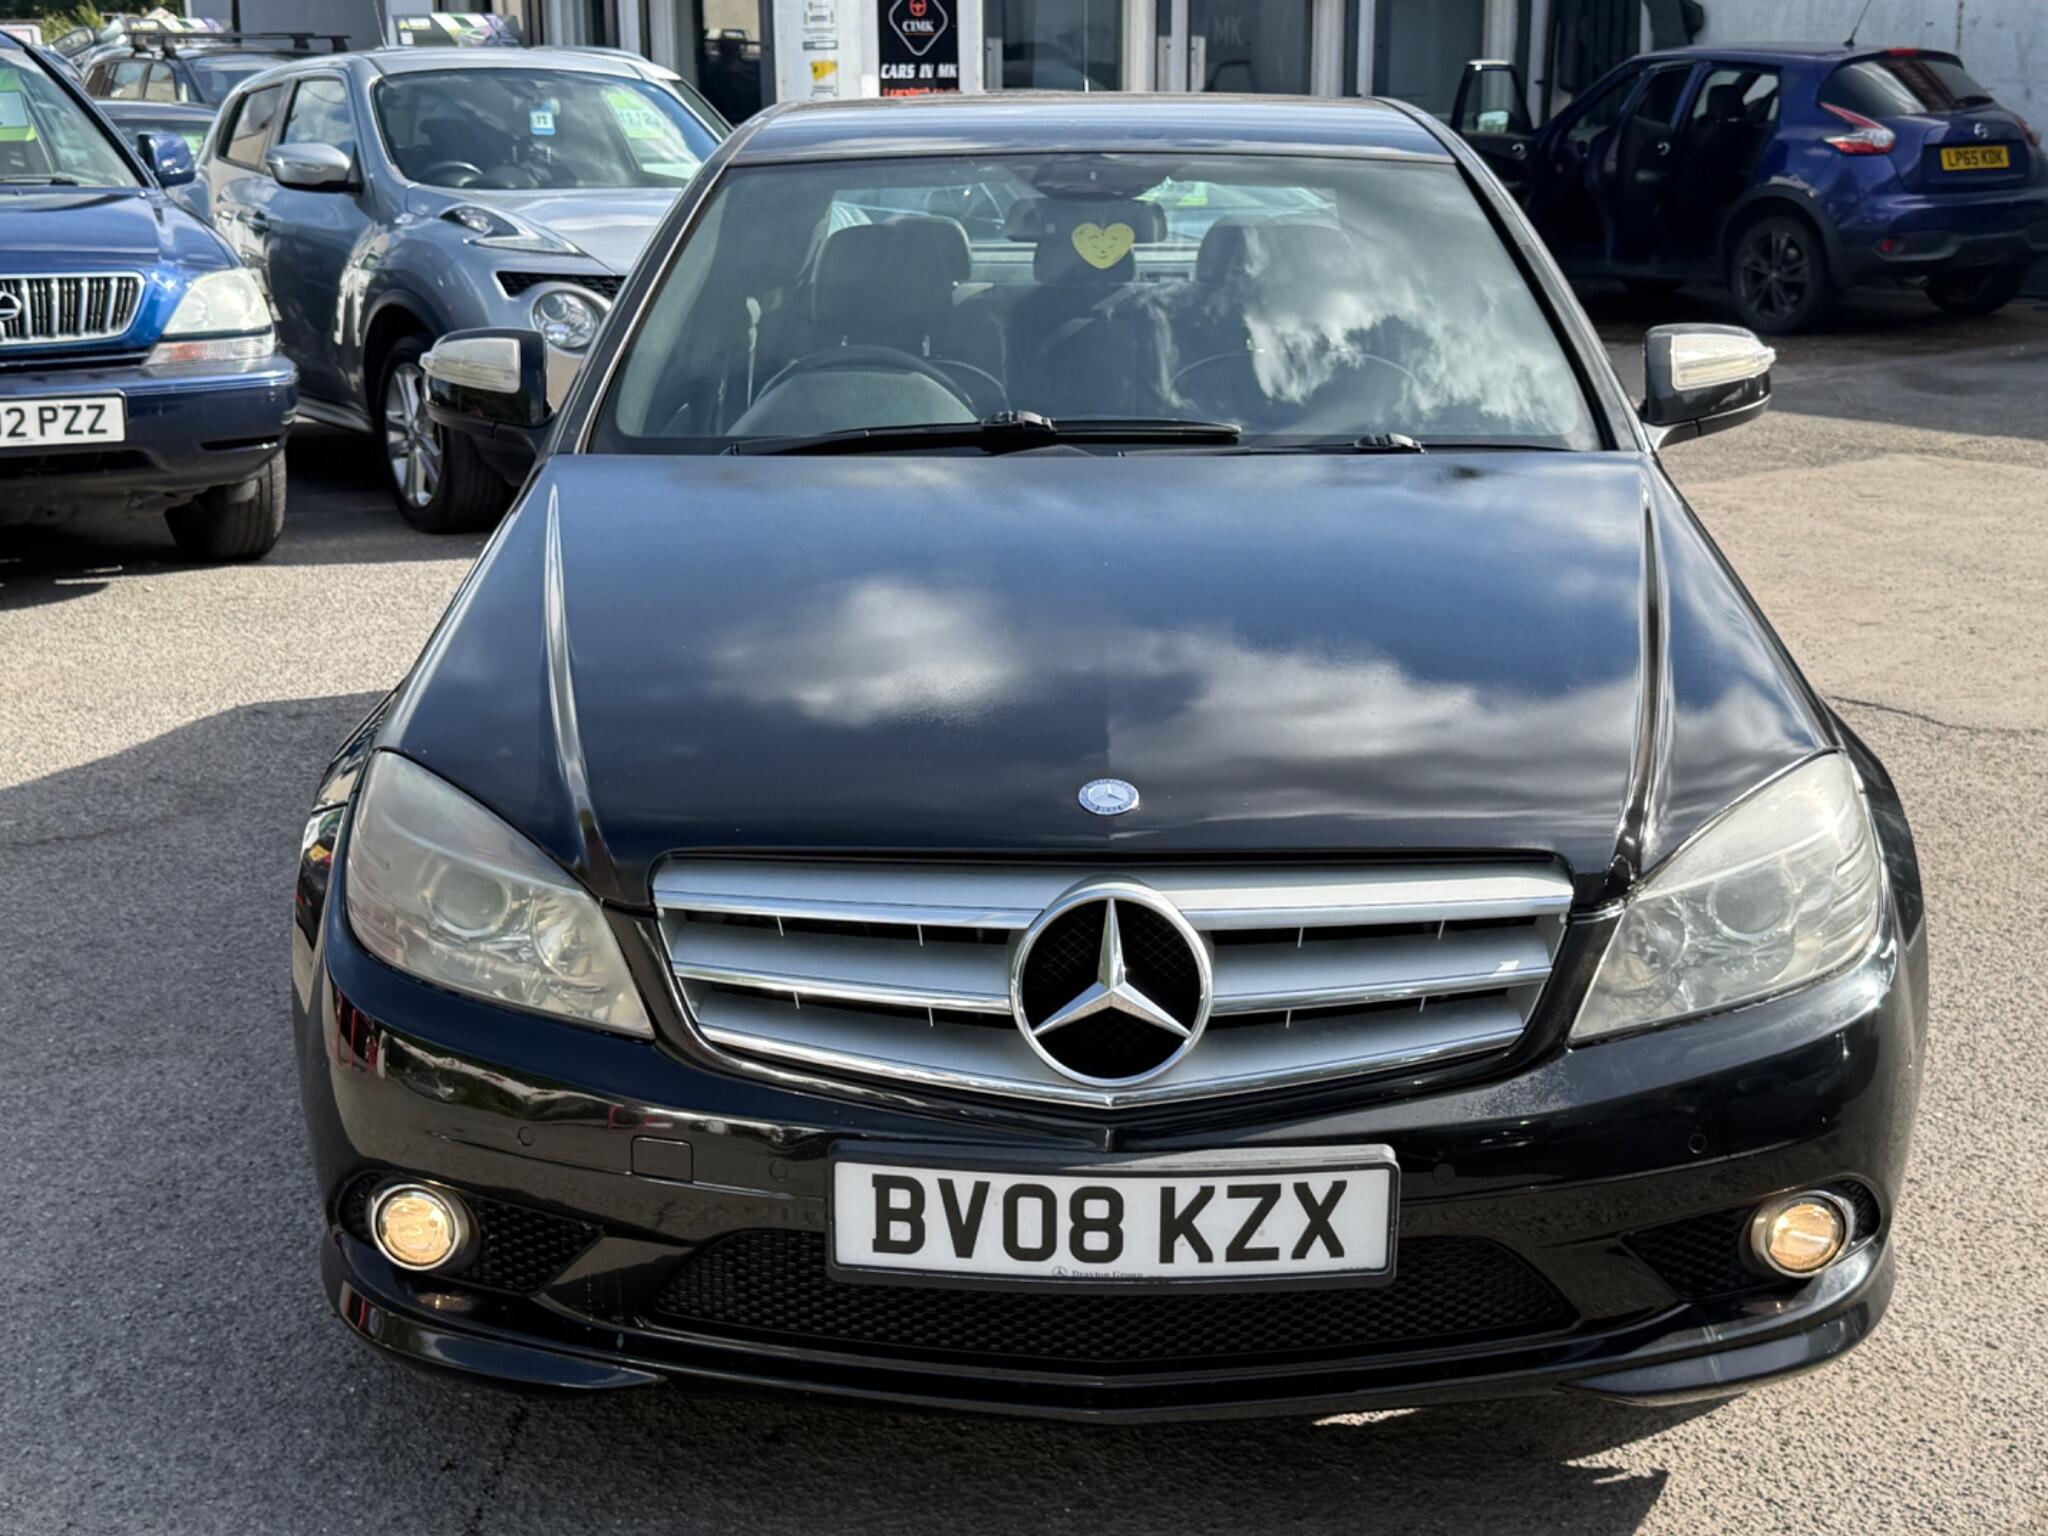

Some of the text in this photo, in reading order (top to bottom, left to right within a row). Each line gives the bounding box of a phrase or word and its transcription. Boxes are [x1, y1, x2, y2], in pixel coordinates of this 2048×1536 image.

[901, 20, 935, 33] CIMK
[881, 63, 958, 79] CARS IN MK
[0, 404, 108, 438] 2 PZZ
[872, 1173, 1348, 1265] BV08 KZX
